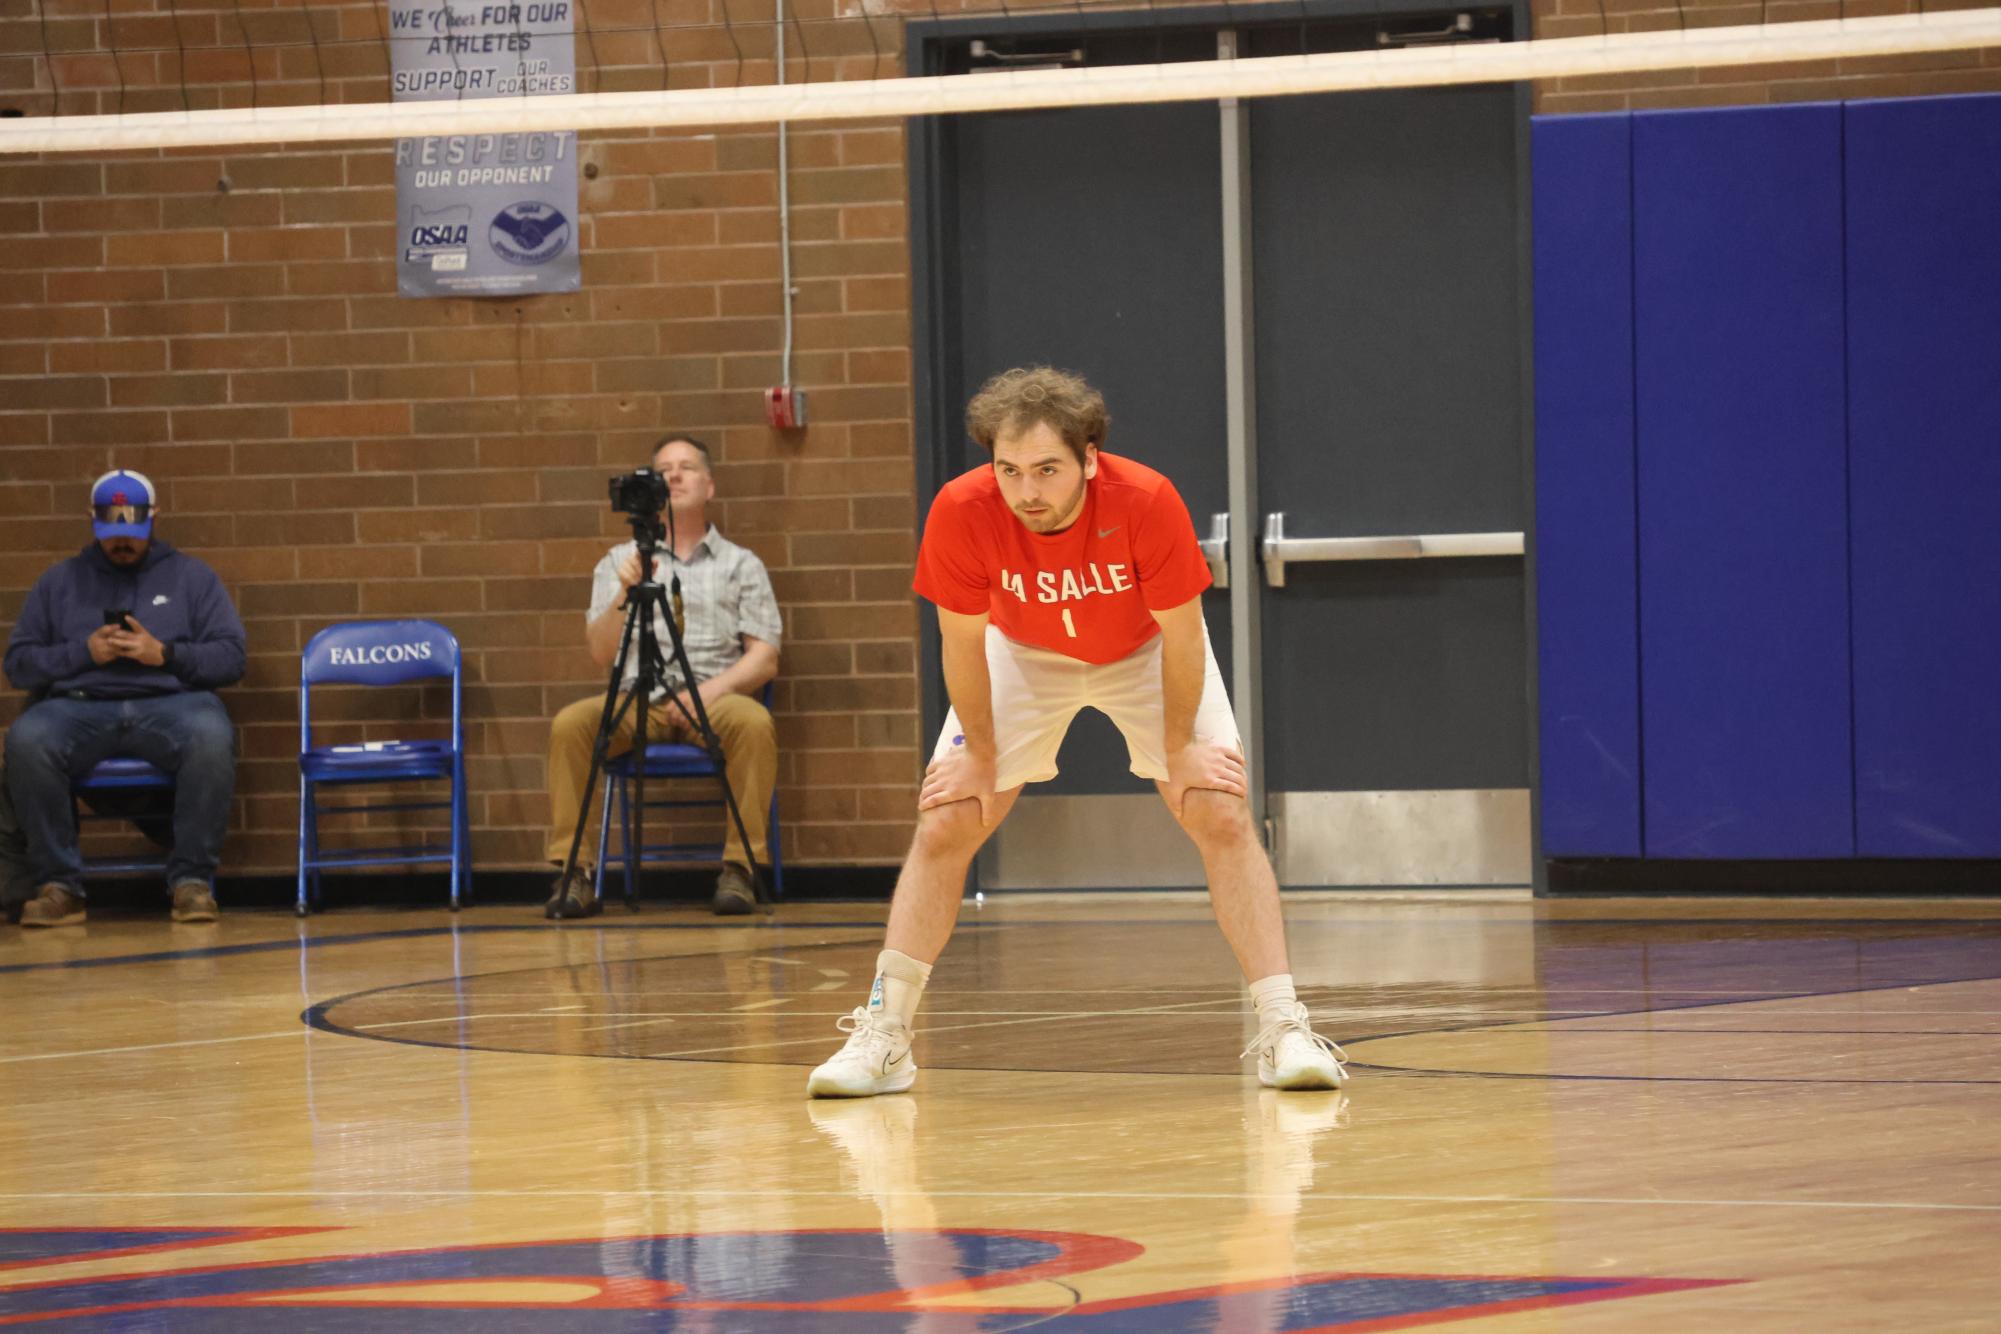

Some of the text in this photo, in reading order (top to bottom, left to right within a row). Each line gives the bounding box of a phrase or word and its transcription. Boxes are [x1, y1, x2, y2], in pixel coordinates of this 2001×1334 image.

[392, 9, 423, 29] WE
[481, 5, 521, 25] FOR
[527, 3, 568, 22] OUR
[427, 32, 532, 55] ATHLETES
[517, 61, 548, 76] OUR
[395, 69, 496, 92] SUPPORT
[497, 76, 570, 93] COACHES
[396, 132, 572, 166] RESPECT
[415, 165, 553, 188] OUR OPPONENT
[411, 224, 469, 246] OSAA
[1037, 563, 1133, 604] SALLE
[1061, 608, 1077, 638] 1
[330, 641, 432, 665] FALCONS
